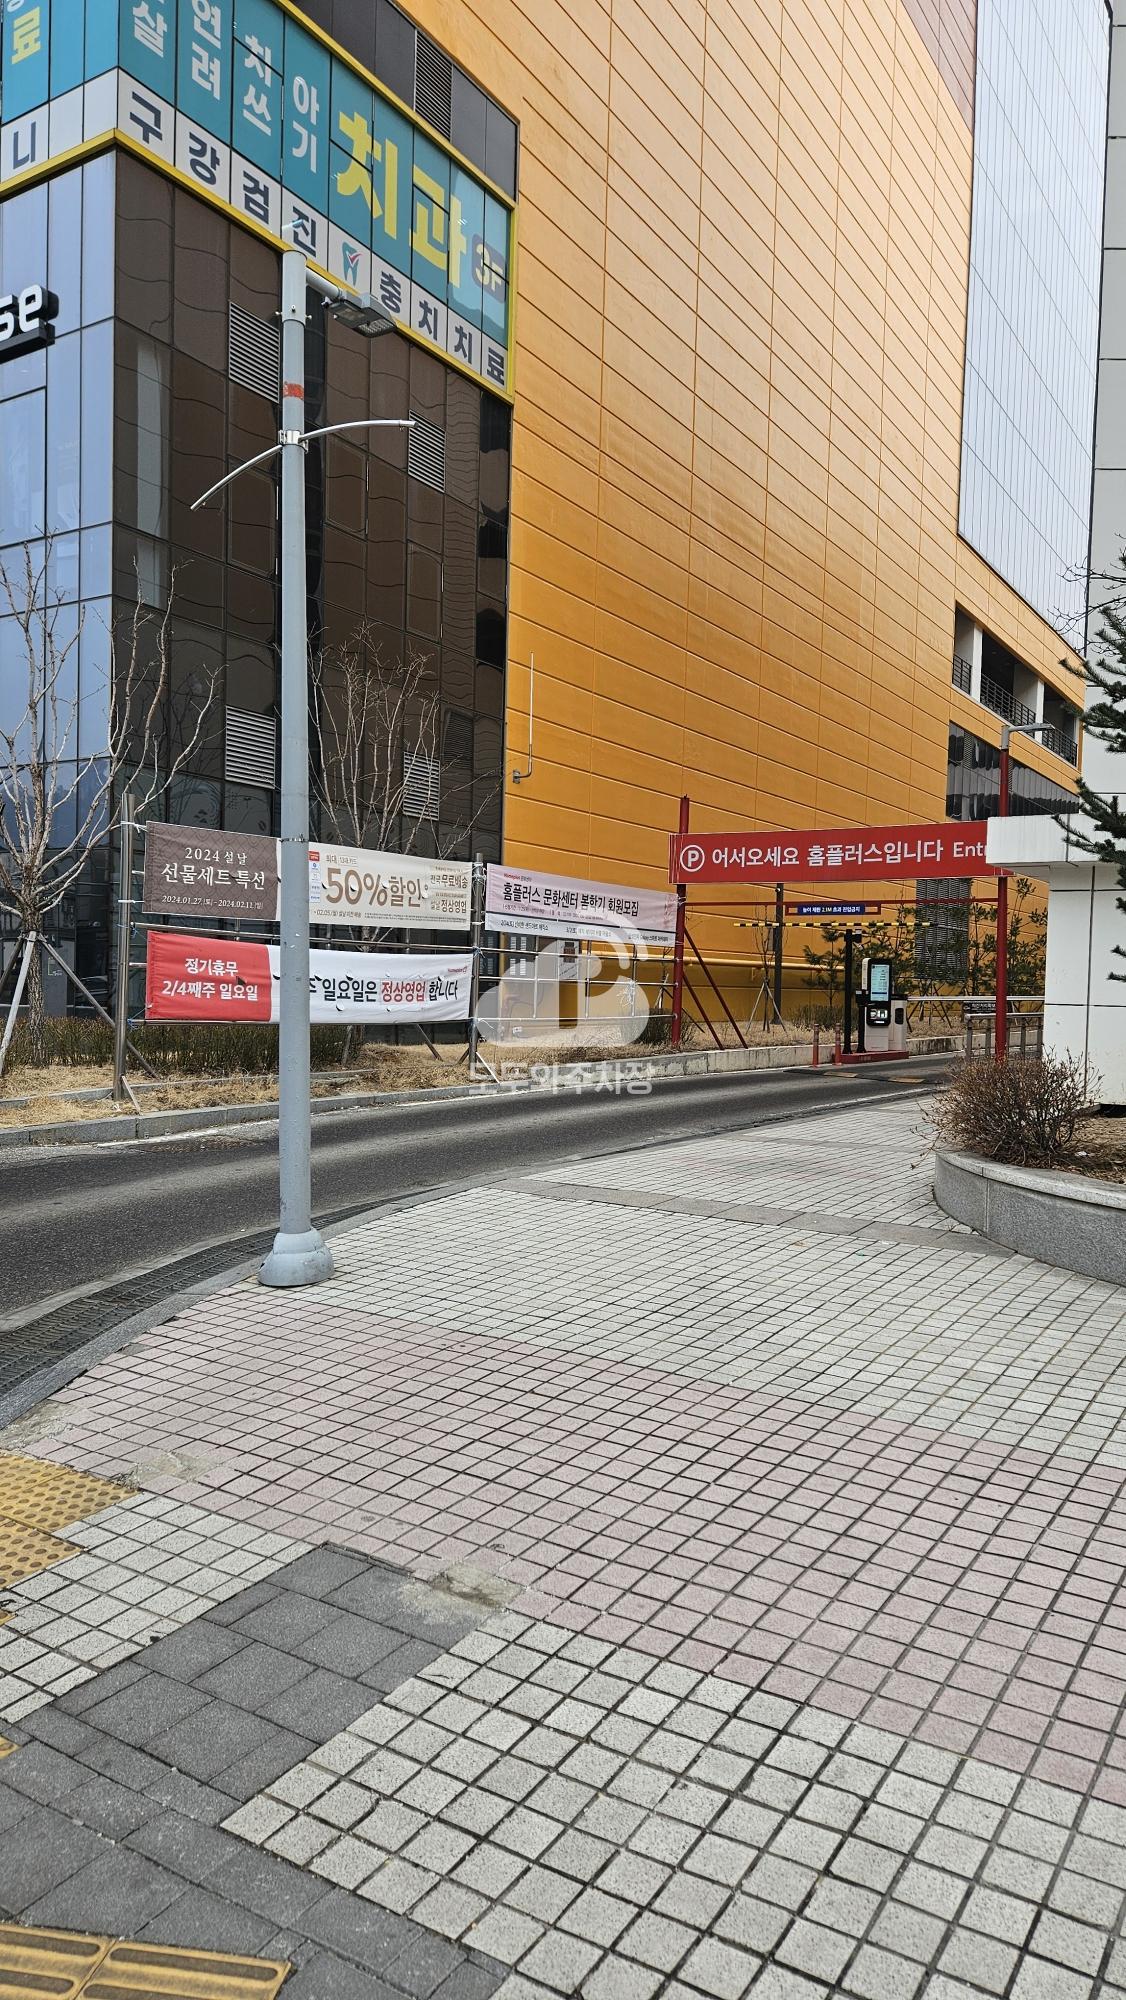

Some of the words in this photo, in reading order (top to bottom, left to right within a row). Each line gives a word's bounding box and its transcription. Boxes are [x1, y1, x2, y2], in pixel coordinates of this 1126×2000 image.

[129, 91, 317, 258] 구강검진
[336, 111, 468, 289] 치과
[474, 242, 504, 291] 3F
[379, 270, 505, 386] 충치치료
[185, 847, 220, 862] 2024
[223, 851, 248, 866] 설날
[711, 846, 800, 869] 어서오세요
[806, 839, 944, 867] 홈플러스입니다
[953, 841, 987, 858] Ent
[160, 862, 232, 887] 선물세트
[235, 870, 265, 890] 특선
[325, 867, 421, 907] 50%할인
[441, 874, 468, 889] 무료배송
[441, 899, 467, 914] 정상영업
[503, 882, 541, 903] 홈플러스
[543, 888, 579, 910] 문화센터
[580, 894, 606, 913] 봄학기
[607, 898, 639, 917] 회원모집
[184, 957, 239, 977] 정기휴무
[161, 980, 216, 999] 2/4째주
[219, 983, 258, 1002] 일요일
[322, 977, 378, 1003] 일요일은
[381, 980, 426, 1003] 정상영업
[428, 980, 458, 1003] 합니다
